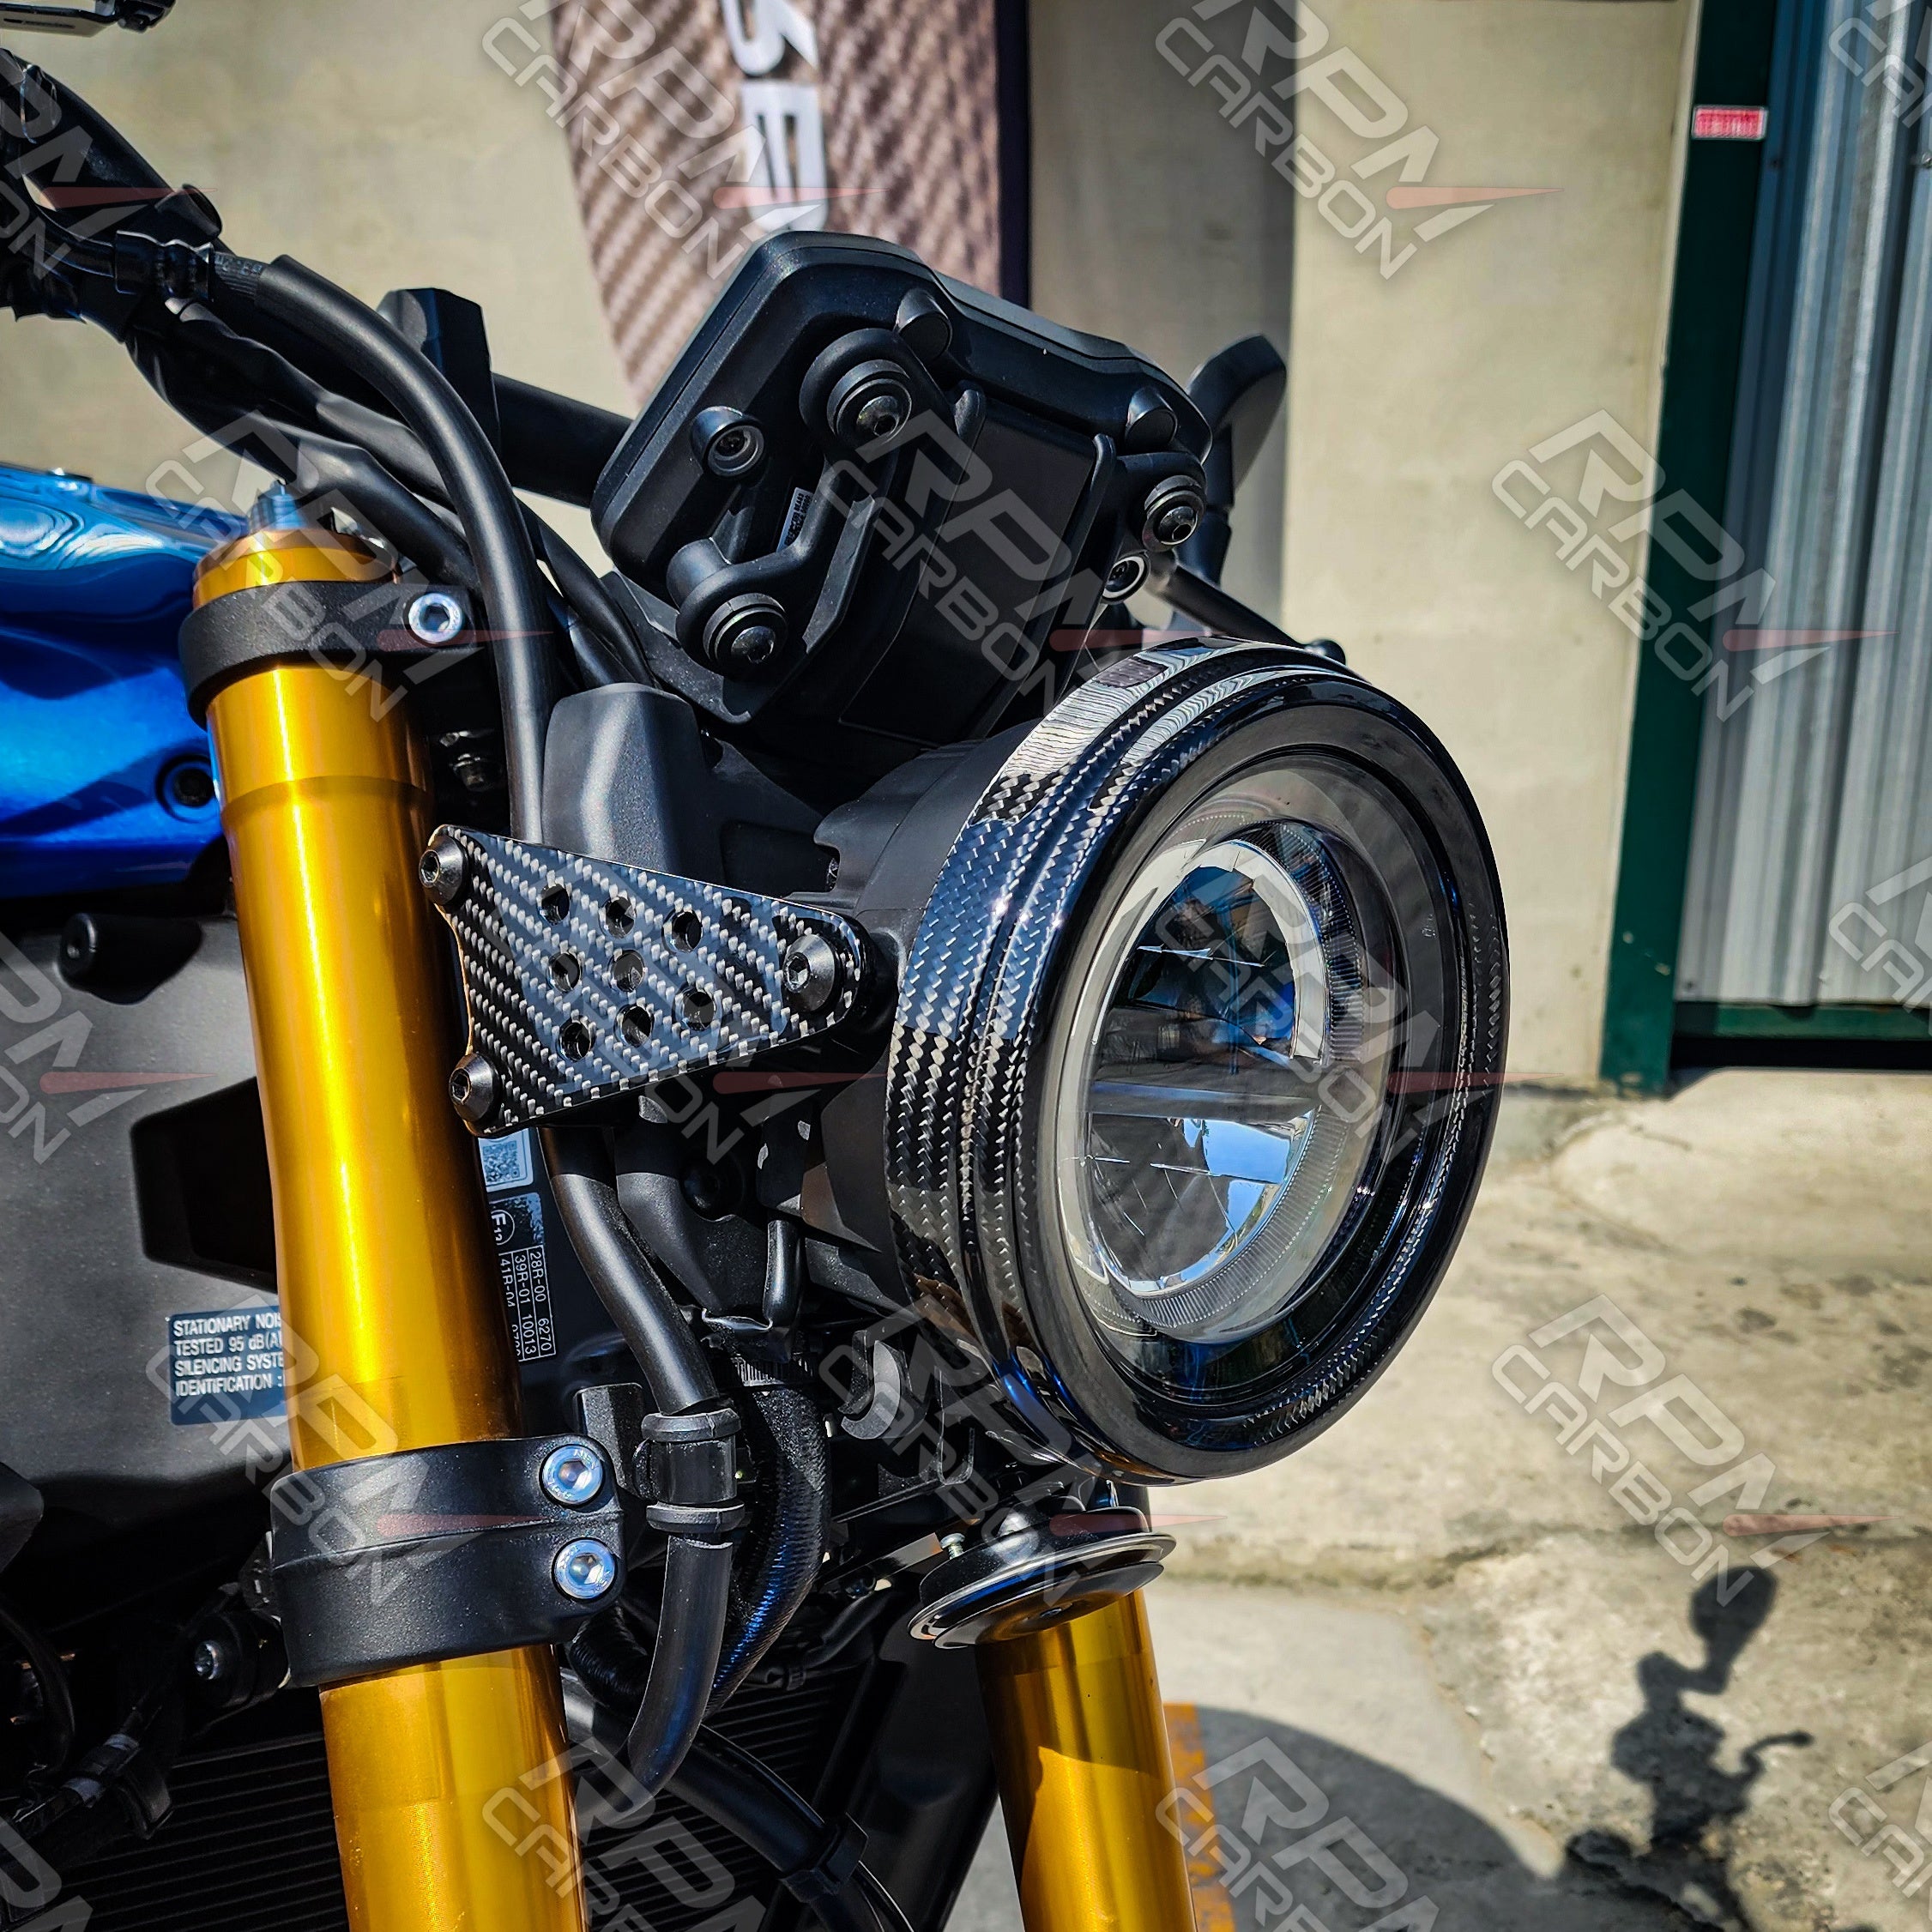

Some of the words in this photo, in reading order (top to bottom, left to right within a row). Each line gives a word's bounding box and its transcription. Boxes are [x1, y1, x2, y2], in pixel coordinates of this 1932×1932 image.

[515, 1254, 531, 1305] 39R-01
[529, 1252, 547, 1303] 28R-00
[173, 1315, 251, 1337] STATIONARY
[521, 1313, 537, 1355] 10013
[537, 1317, 552, 1351] 6270
[174, 1337, 223, 1356] TESTED
[228, 1335, 245, 1353] 95
[174, 1355, 242, 1377] SILENCING
[175, 1374, 272, 1397] IDENTIFICATION
